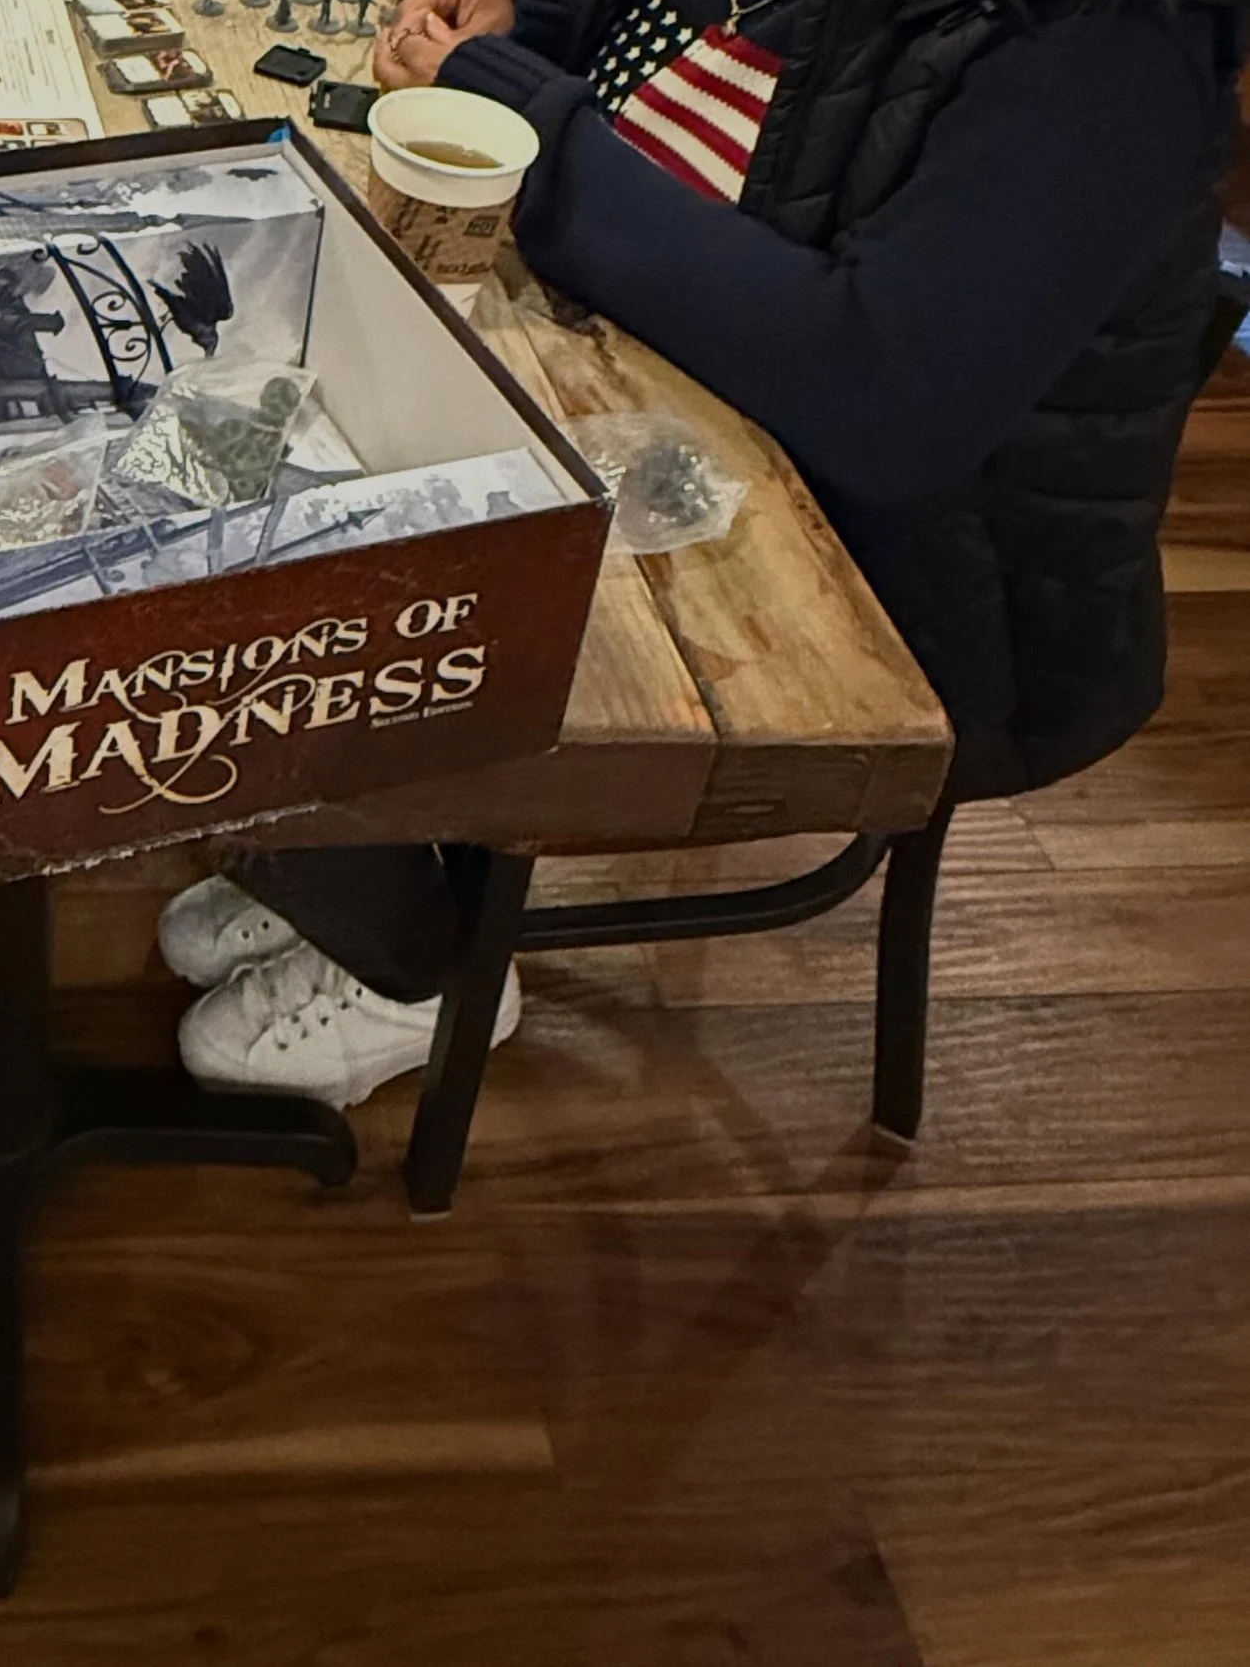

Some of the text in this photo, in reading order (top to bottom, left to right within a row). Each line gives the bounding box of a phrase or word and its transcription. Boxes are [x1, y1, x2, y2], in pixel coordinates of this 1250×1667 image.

[5, 592, 479, 726] MANSIONS OF
[370, 700, 475, 728] SECOND EDITION
